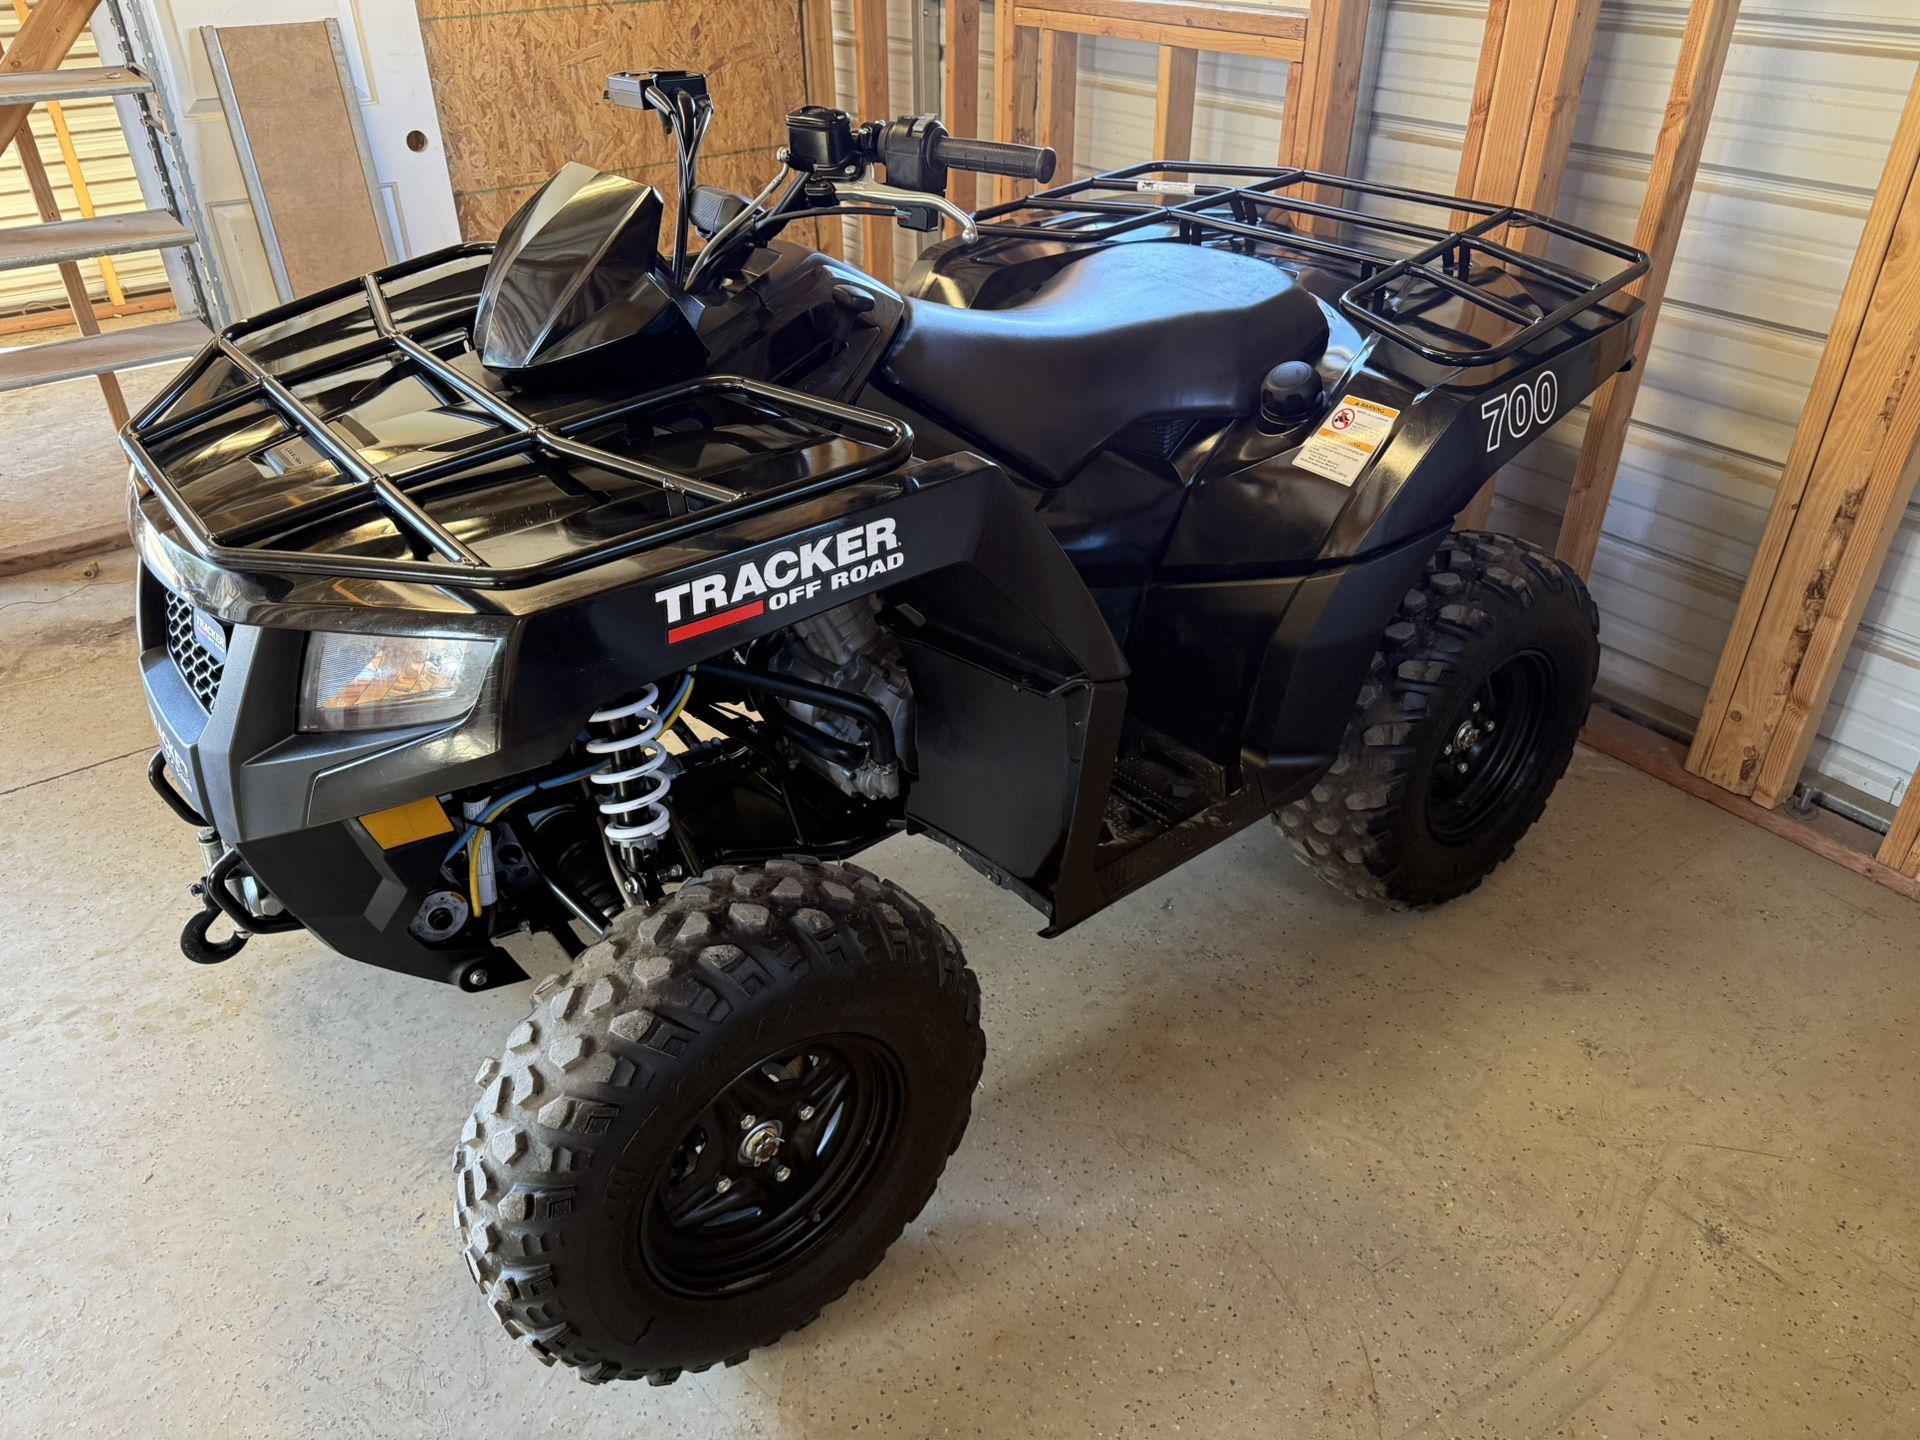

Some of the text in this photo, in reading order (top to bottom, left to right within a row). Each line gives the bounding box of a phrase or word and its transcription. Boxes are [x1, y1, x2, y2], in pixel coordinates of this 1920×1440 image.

[1481, 370, 1558, 453] 700
[655, 518, 897, 624] TRACKER
[769, 552, 904, 611] OFF ROAD
[196, 615, 225, 648] TRACKER
